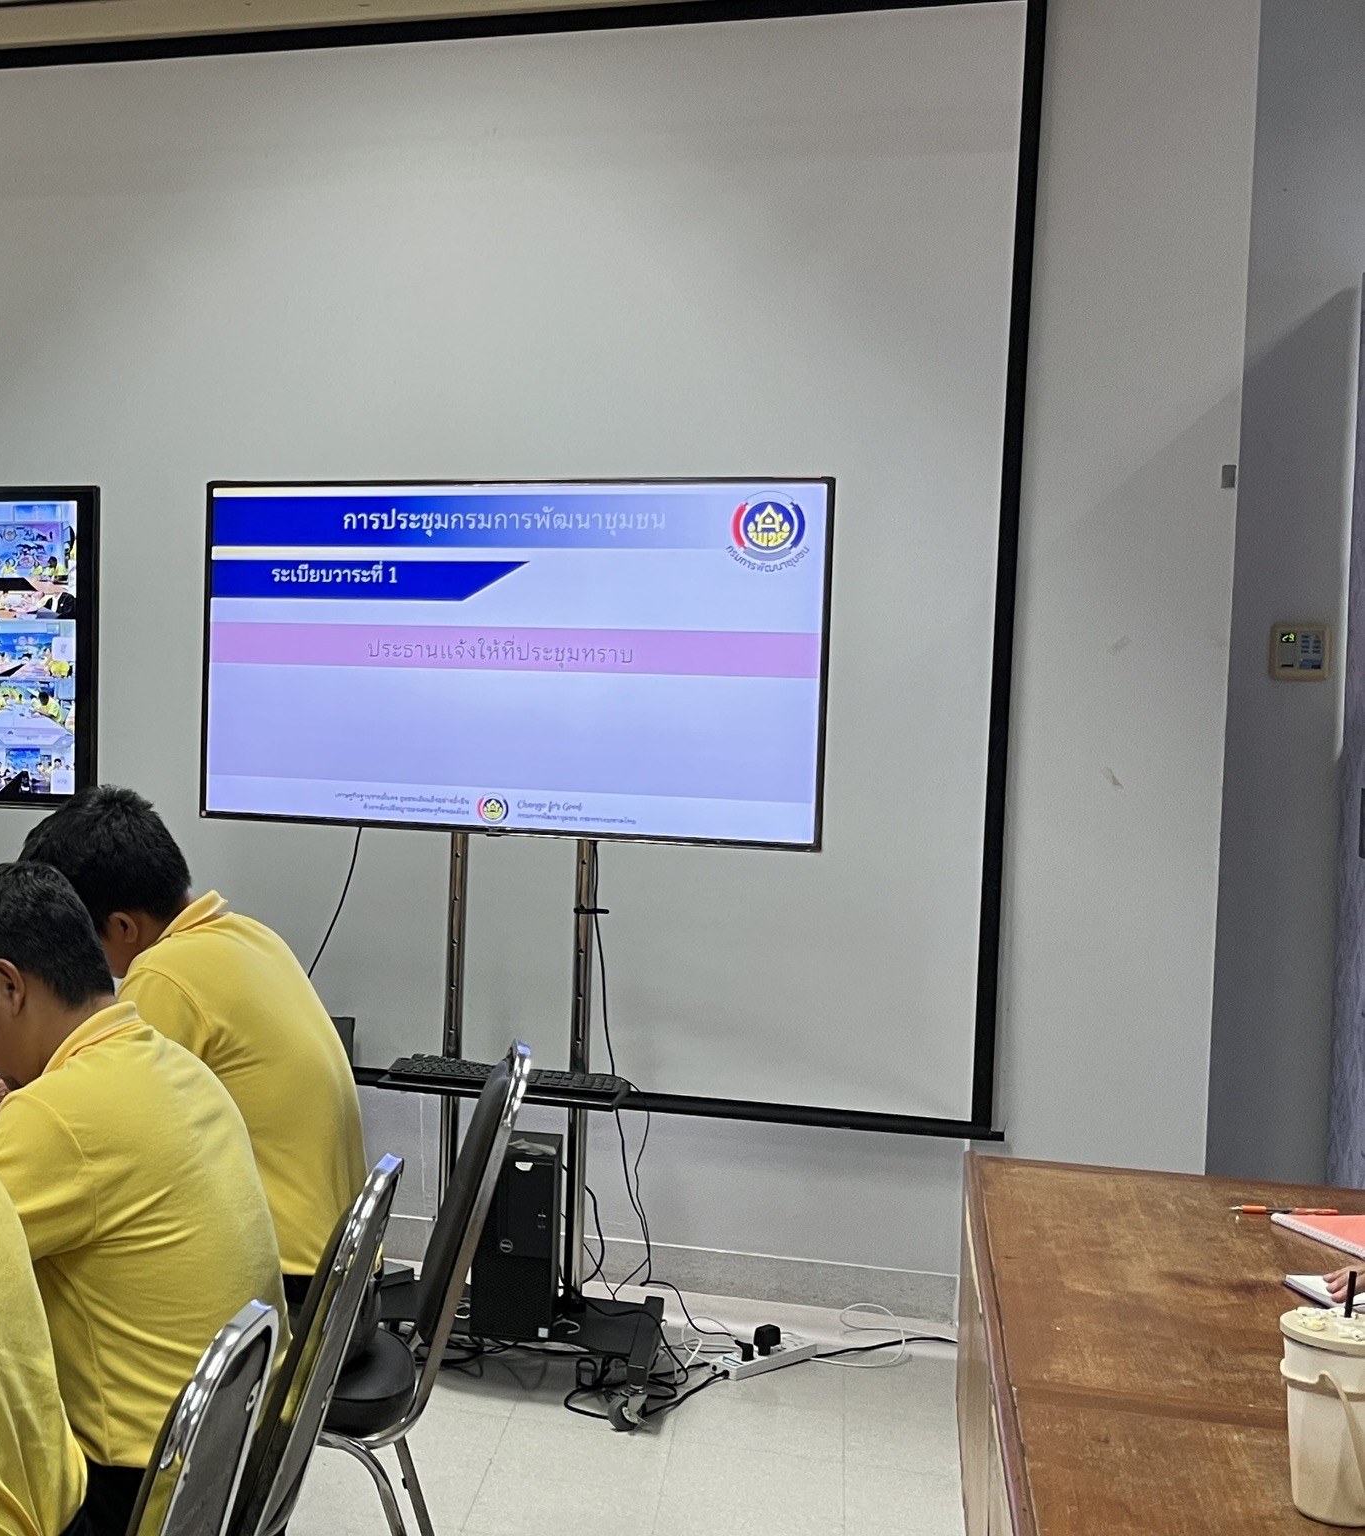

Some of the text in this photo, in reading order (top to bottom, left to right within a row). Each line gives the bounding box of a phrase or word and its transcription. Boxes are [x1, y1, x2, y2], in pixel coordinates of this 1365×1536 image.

[343, 506, 666, 537] การประชุมกรมการพัฒนาชุมชน
[271, 560, 397, 583] ระเบียบวาระที่ 1
[368, 638, 633, 668] ประธานแจ้งให้ที่ประชุมทราบ
